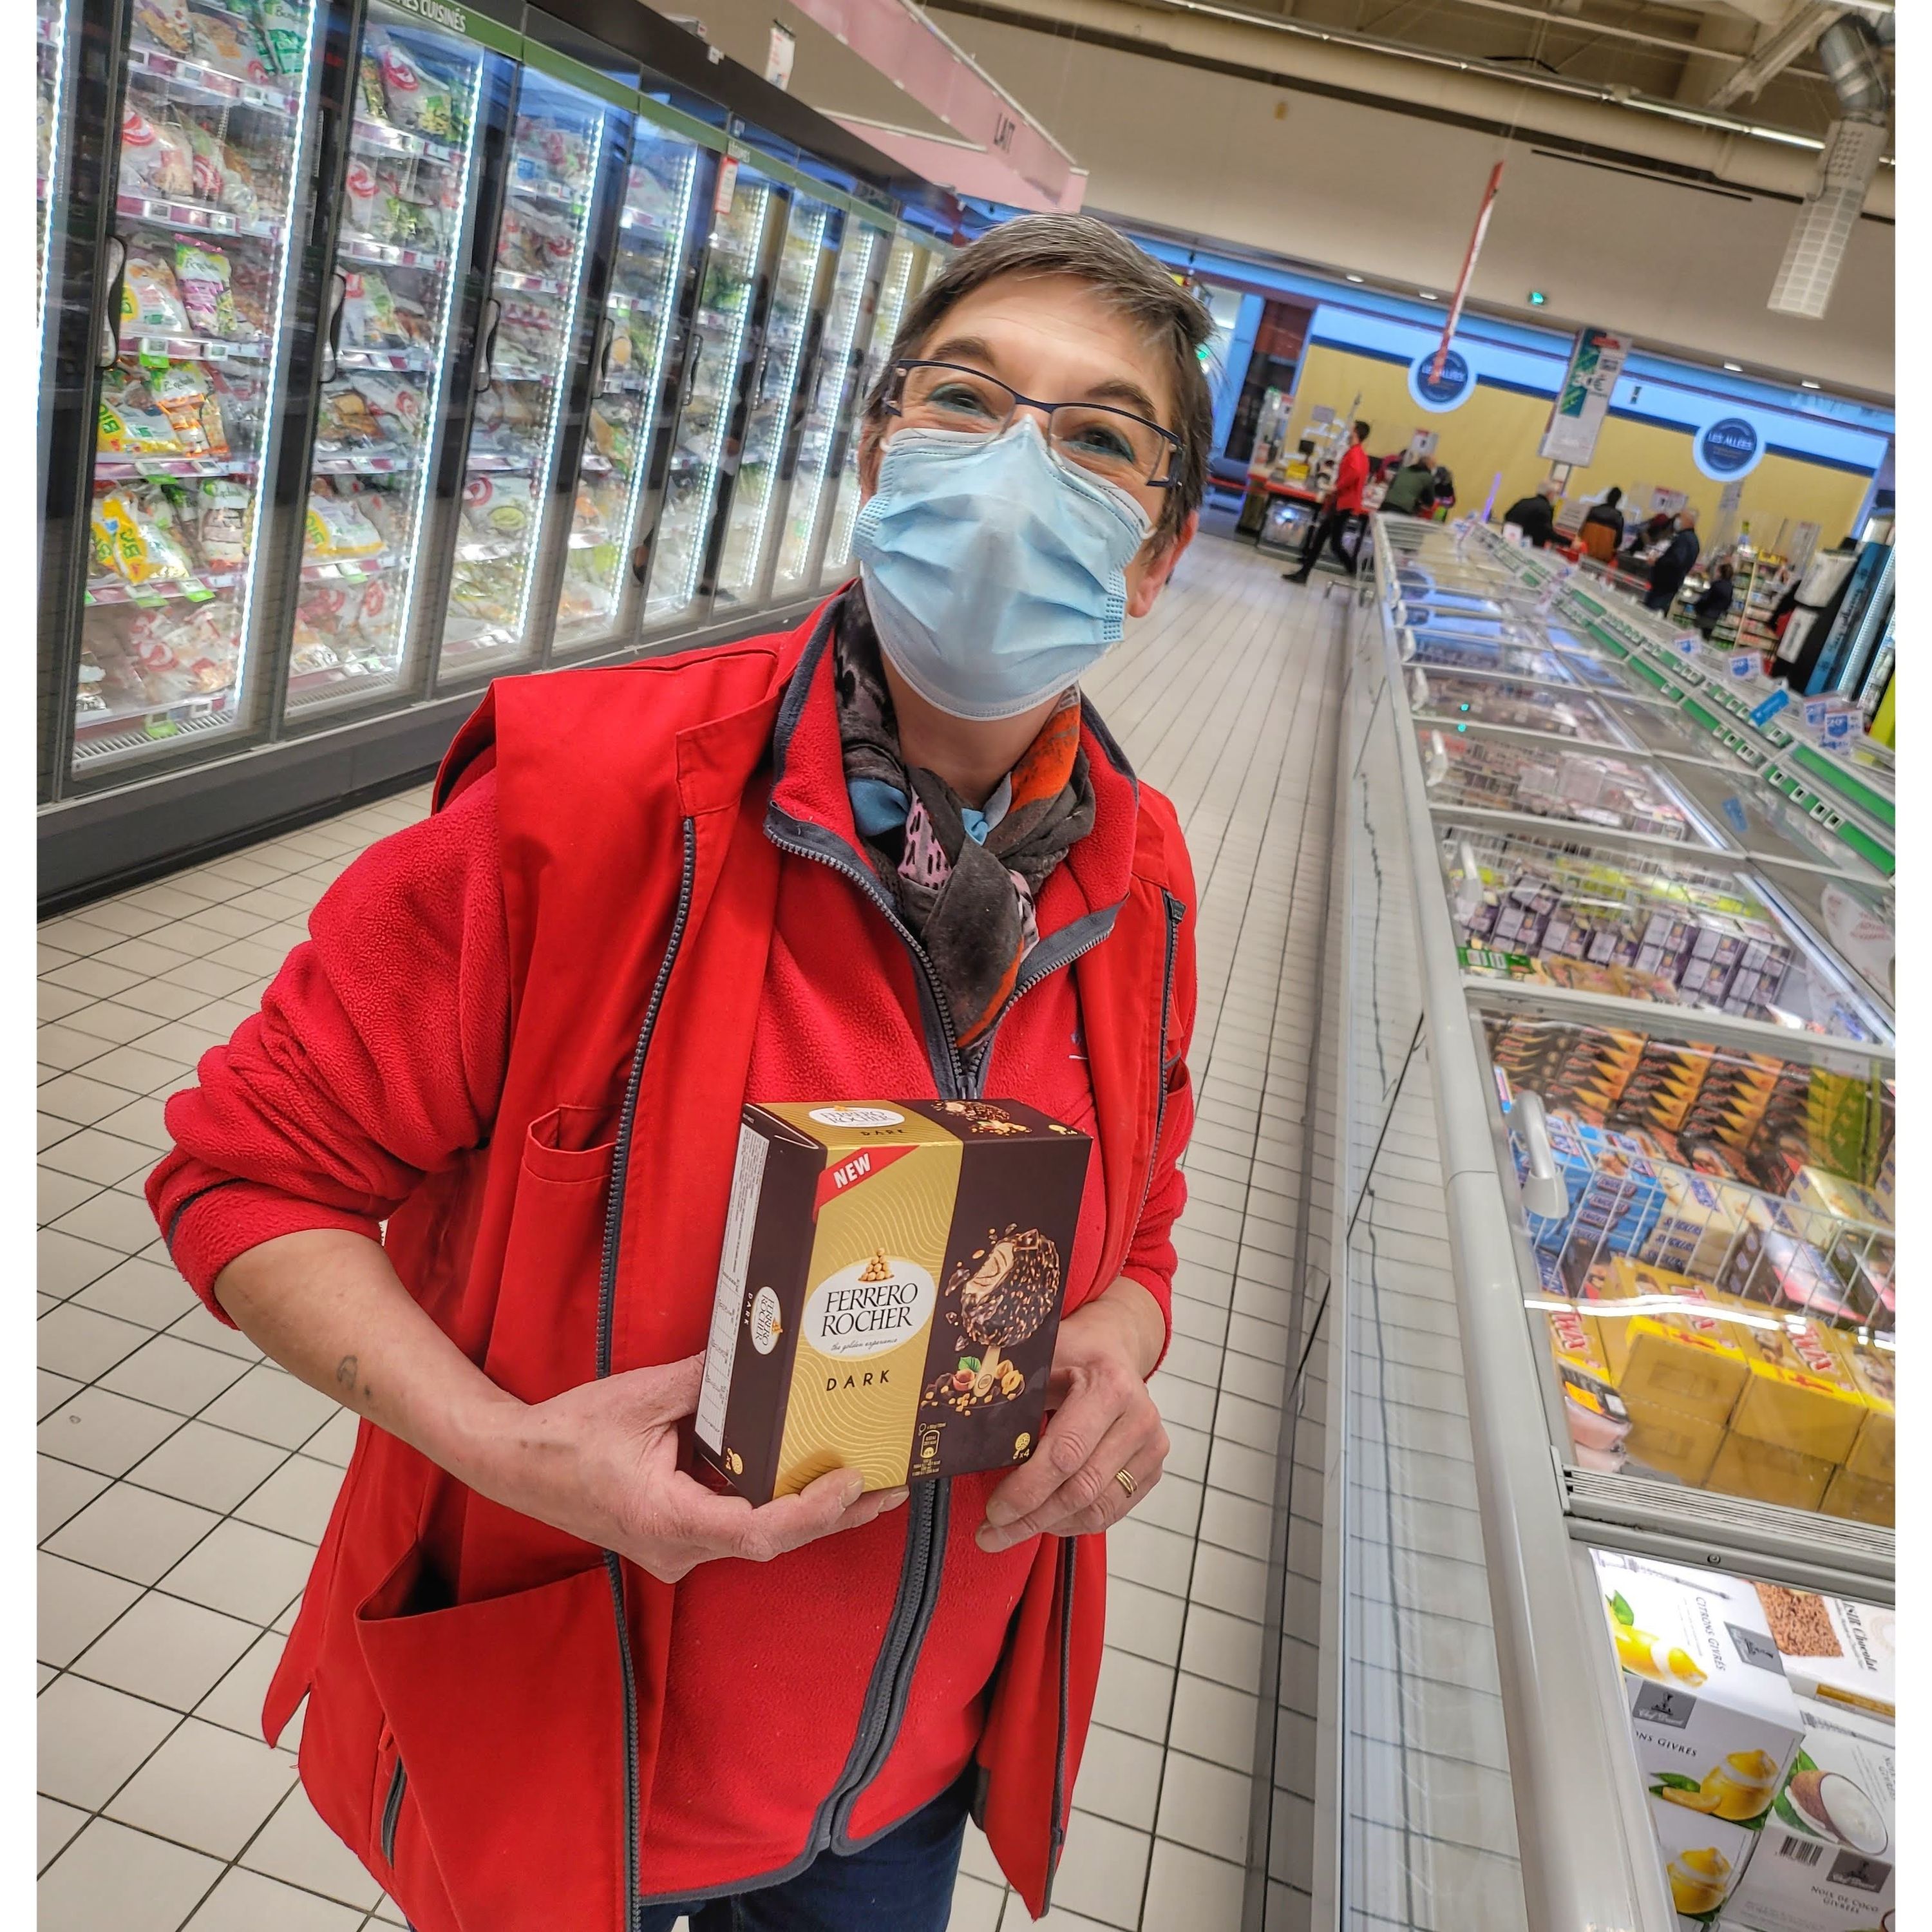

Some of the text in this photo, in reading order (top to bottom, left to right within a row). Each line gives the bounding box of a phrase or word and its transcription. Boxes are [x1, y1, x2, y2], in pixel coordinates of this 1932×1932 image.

[420, 0, 466, 33] CUISINÉS
[820, 1110, 886, 1119] FERRERO
[828, 1114, 894, 1124] ROCHER
[833, 1153, 871, 1189] NEW
[744, 1293, 753, 1325] DARK
[824, 1283, 918, 1313] FERRERO
[755, 1298, 768, 1341] ROCHER
[762, 1294, 775, 1346] FERRERO
[820, 1306, 913, 1337] ROCHER
[831, 1338, 898, 1354] the golden experience
[826, 1370, 890, 1391] DARK
[725, 1455, 732, 1470] x4
[1019, 1448, 1030, 1458] x4
[1696, 1596, 1715, 1636] CITRONS
[1853, 1628, 1878, 1672] Chocolat
[1811, 1886, 1879, 1912] NOIX DE COCO
